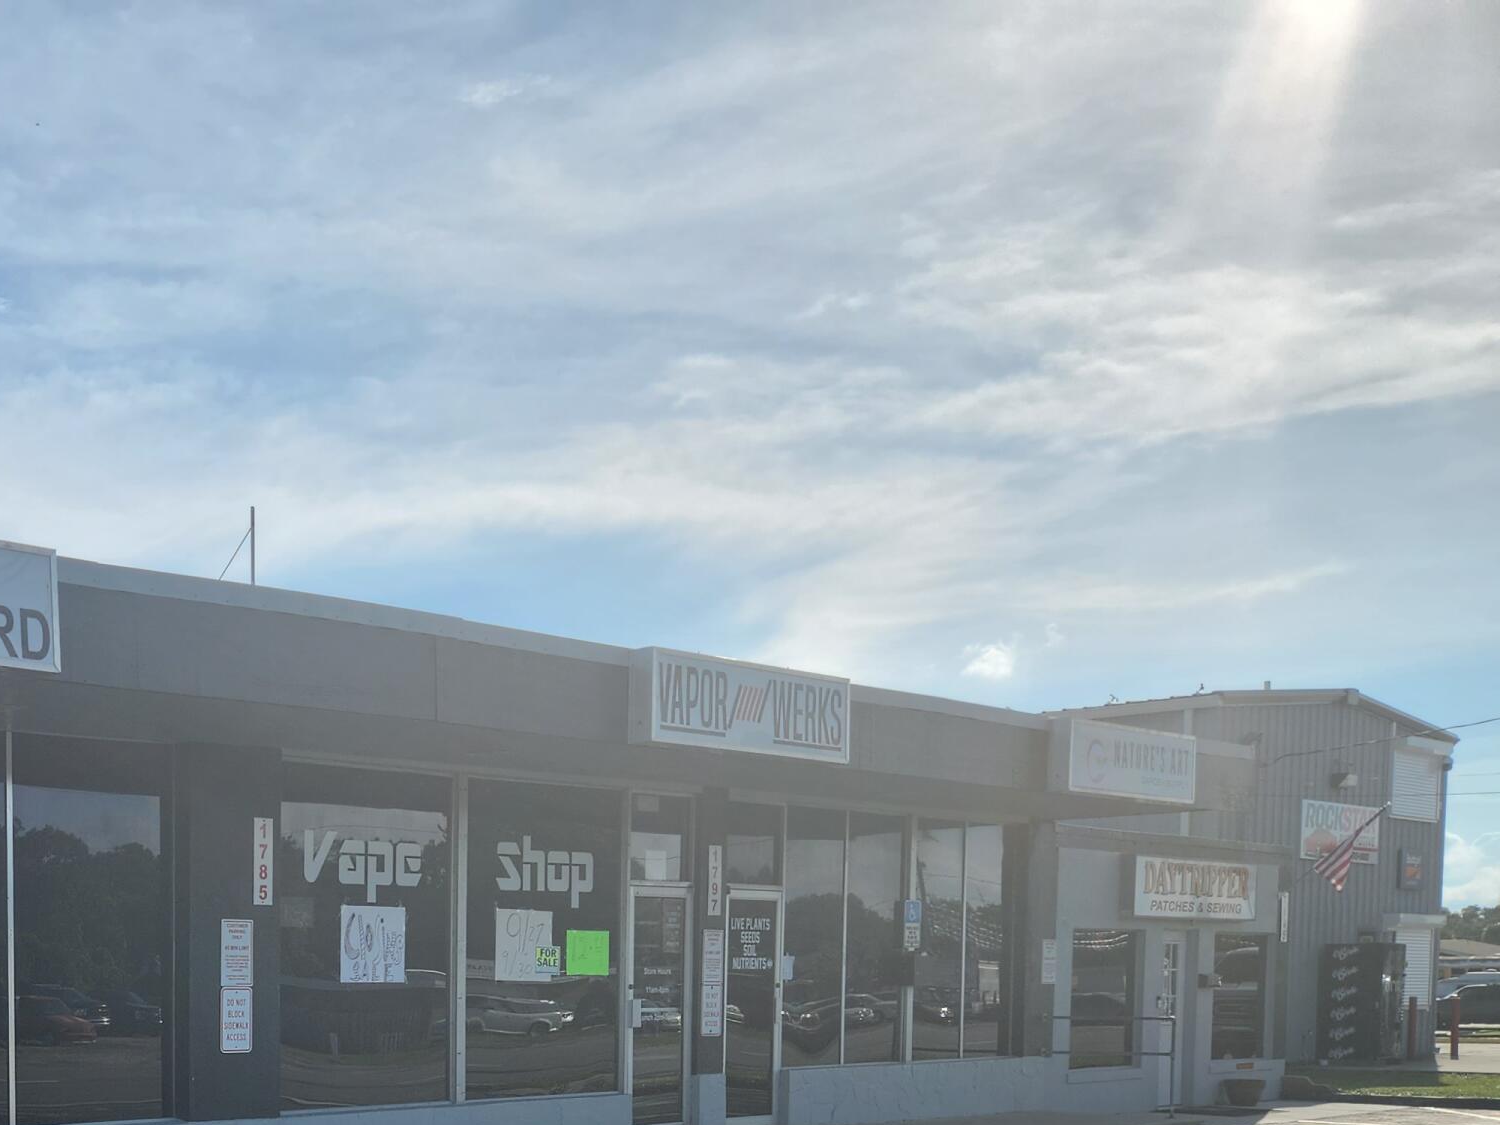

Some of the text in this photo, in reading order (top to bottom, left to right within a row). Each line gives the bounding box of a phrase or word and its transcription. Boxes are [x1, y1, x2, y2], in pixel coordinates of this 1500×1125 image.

[659, 662, 842, 747] VAPOR WERKS
[1171, 747, 1189, 776] ART
[259, 823, 268, 900] 1785
[303, 829, 422, 903] Vape
[1143, 860, 1251, 900] DAYTRIPPER
[1150, 900, 1195, 912] PATCHES
[1206, 903, 1242, 914] SEWING
[730, 917, 770, 930] LIVE PLANTS
[740, 931, 760, 943] SEEDS
[540, 948, 557, 958] FOR
[743, 944, 757, 957] SOIL
[537, 957, 558, 967] SALE
[732, 957, 767, 970] NUTRIENTS
